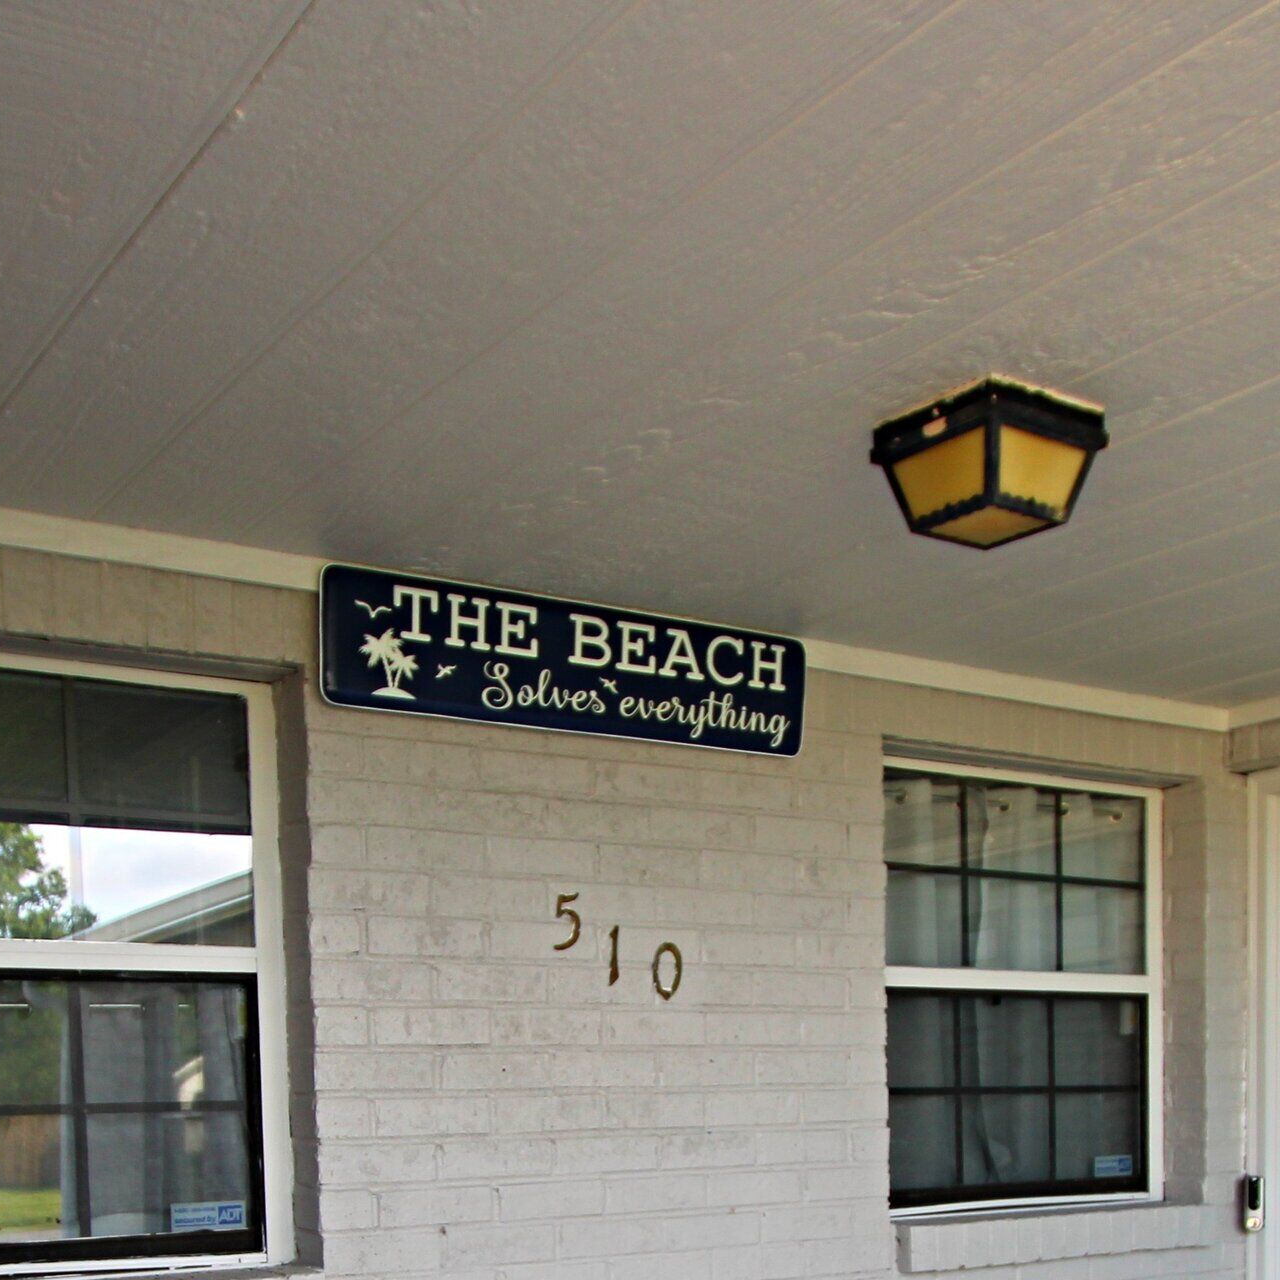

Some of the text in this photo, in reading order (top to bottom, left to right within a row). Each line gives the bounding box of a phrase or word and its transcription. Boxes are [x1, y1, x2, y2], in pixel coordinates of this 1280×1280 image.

[392, 584, 787, 692] THE BEACH
[480, 659, 791, 748] Solves everything
[553, 891, 683, 1001] 510
[219, 1206, 242, 1223] ADT
